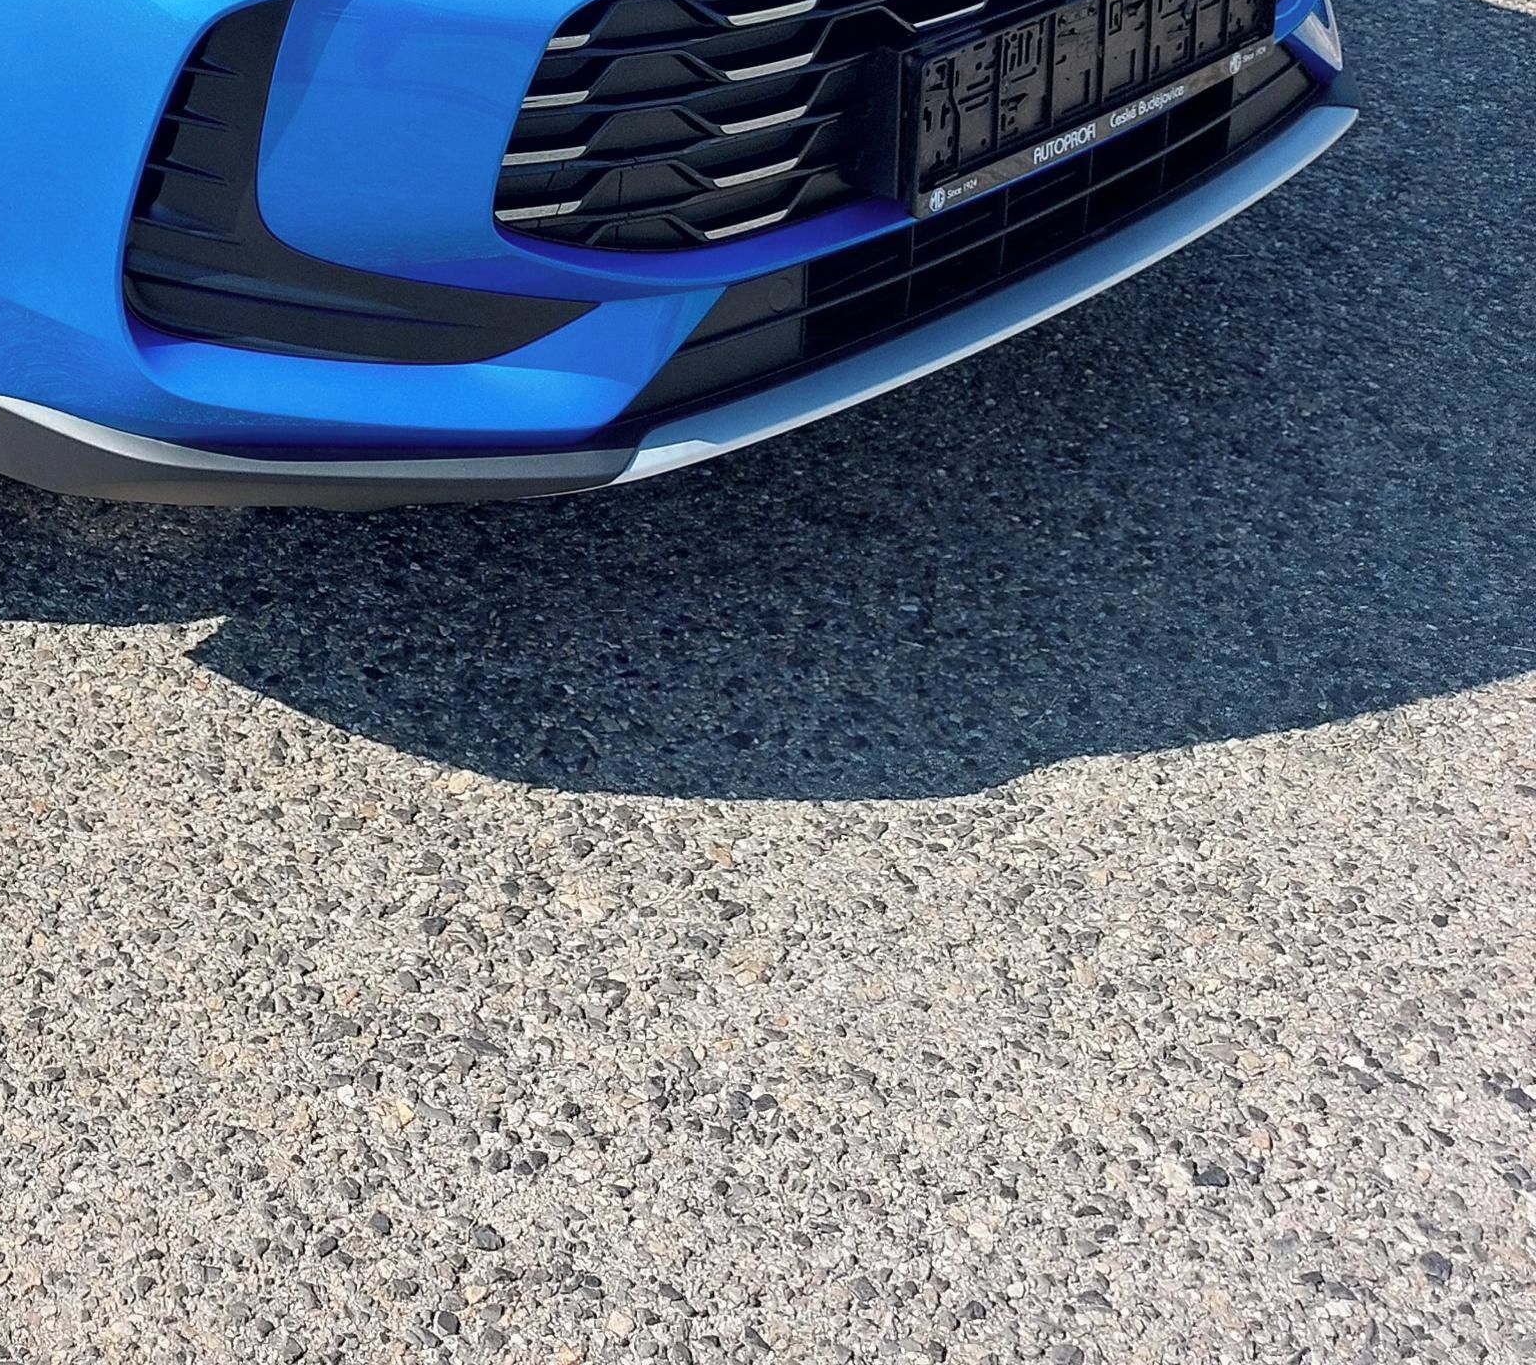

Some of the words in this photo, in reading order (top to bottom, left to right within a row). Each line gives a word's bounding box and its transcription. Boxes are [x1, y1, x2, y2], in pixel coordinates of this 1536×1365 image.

[1033, 122, 1097, 165] AUTOPROFI
[929, 187, 946, 213] MG
[946, 187, 963, 200] Since
[962, 176, 978, 192] 1924
